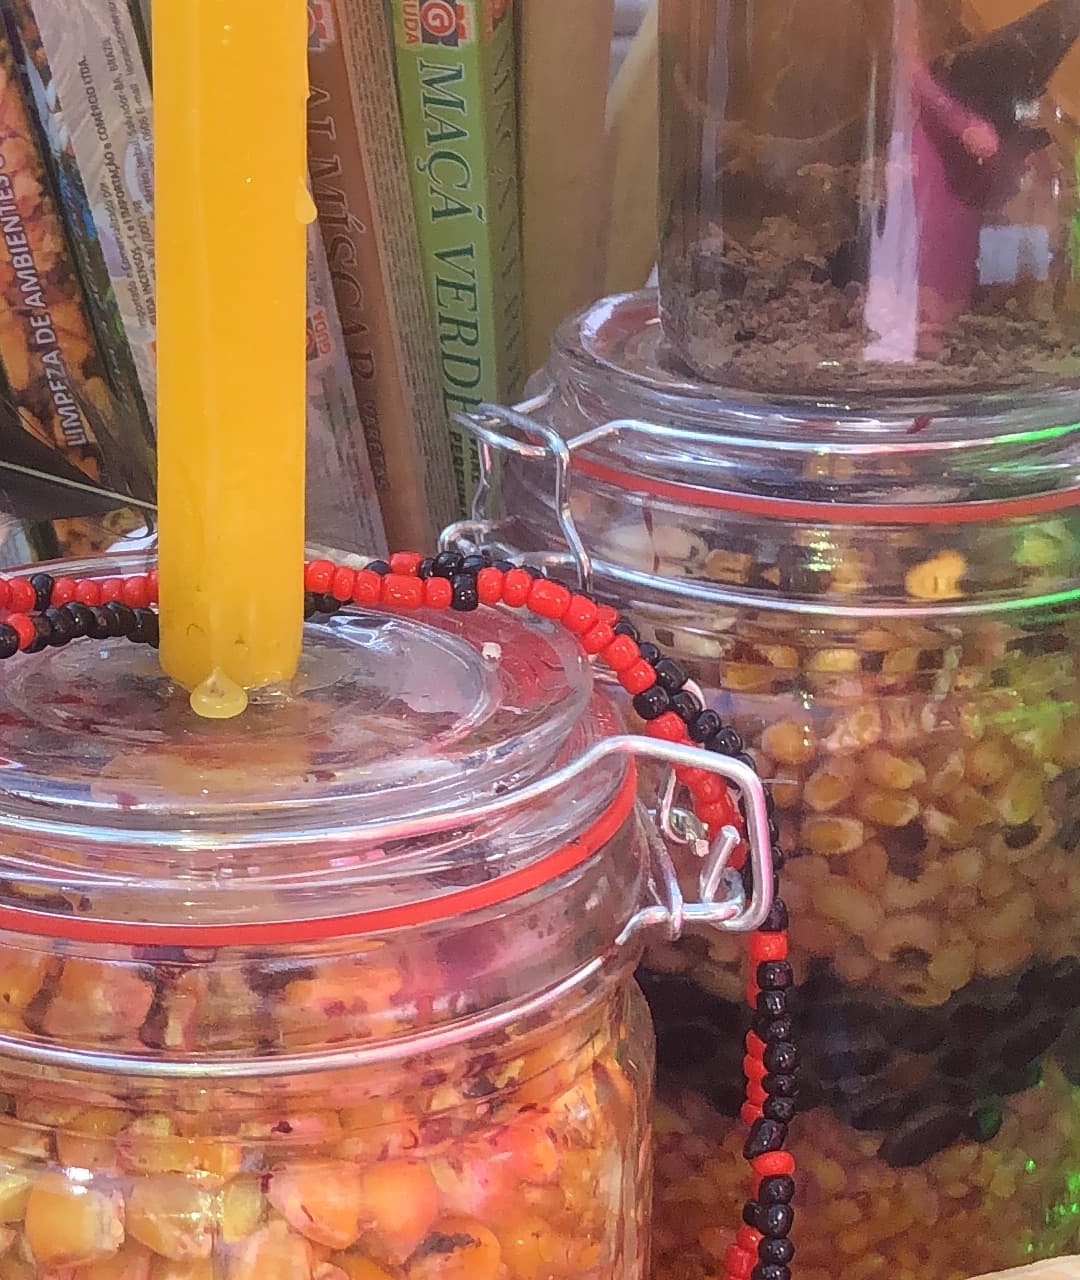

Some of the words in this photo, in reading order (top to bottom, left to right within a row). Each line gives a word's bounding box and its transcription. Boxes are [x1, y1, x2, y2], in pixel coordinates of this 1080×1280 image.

[84, 85, 109, 141] COMÉRCIO
[414, 58, 485, 222] MAÇÃ
[103, 150, 132, 219] IMPORTAÇÃO
[130, 245, 153, 296] INCENSOS
[29, 313, 57, 346] DE
[312, 309, 331, 354] GUDA
[358, 399, 391, 492] VARETAS
